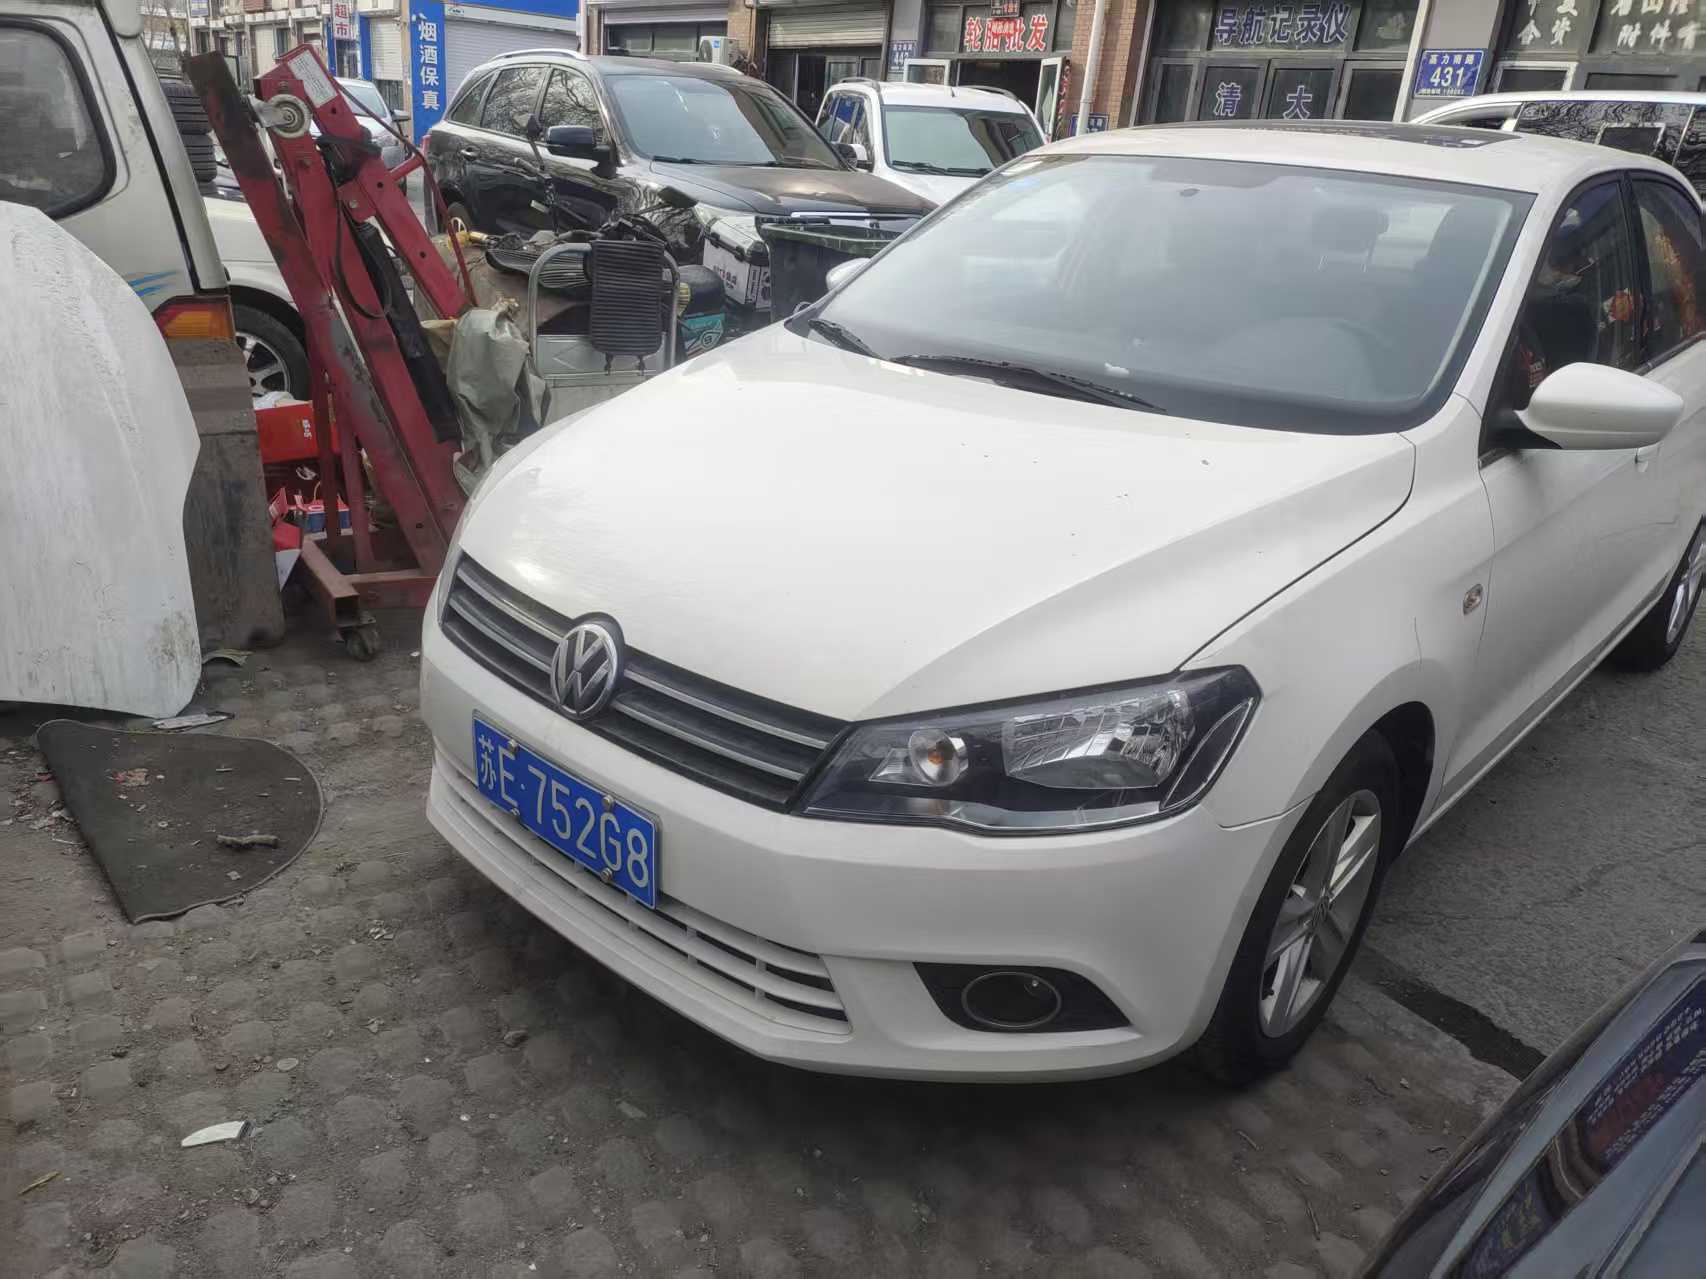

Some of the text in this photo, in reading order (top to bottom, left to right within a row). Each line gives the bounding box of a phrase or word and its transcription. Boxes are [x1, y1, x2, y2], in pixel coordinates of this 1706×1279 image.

[334, 2, 349, 37] 超市
[964, 14, 1049, 52] 轮胎批发
[1215, 1, 1350, 46] 导航记录仪
[418, 22, 440, 110] 烟酒保真
[1429, 66, 1465, 88] 431
[1213, 81, 1241, 117] 清
